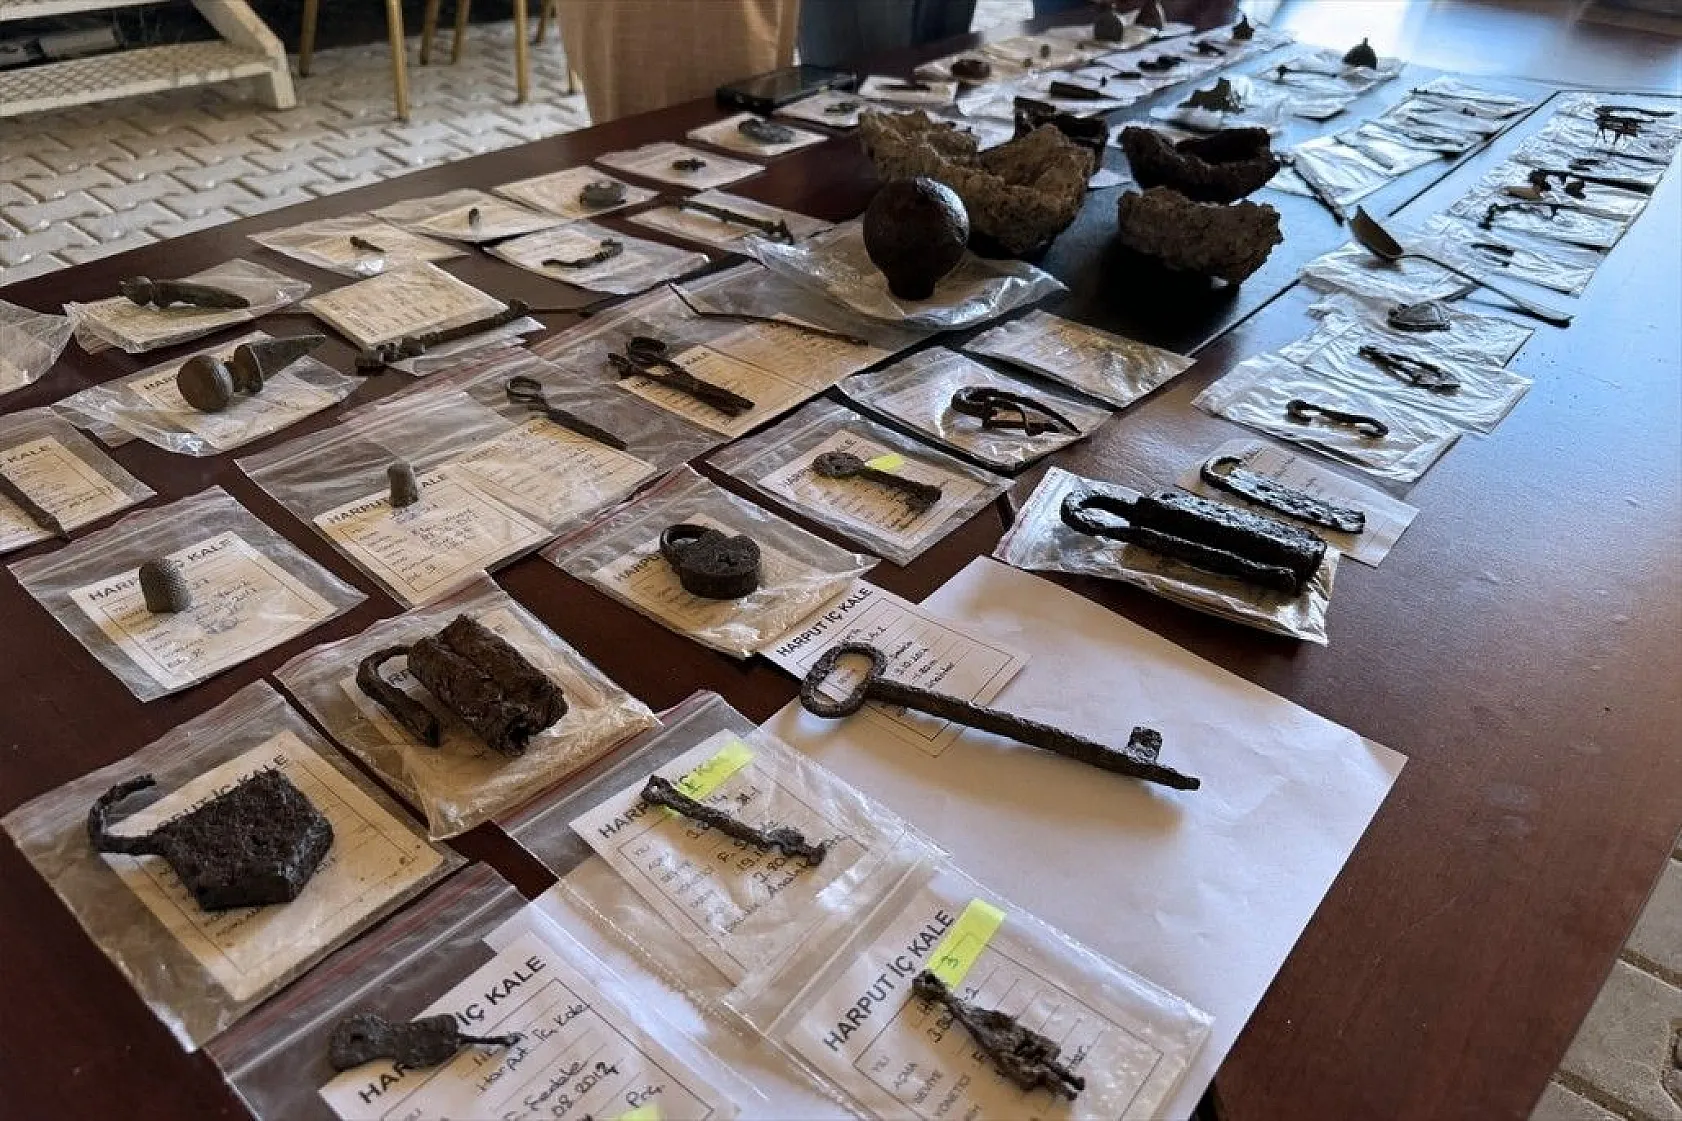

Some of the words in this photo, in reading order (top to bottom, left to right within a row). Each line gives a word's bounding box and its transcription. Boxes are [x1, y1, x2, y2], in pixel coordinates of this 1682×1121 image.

[776, 622, 828, 657] HARPUT
[838, 587, 874, 613] KALE
[456, 1004, 486, 1027] İÇ
[485, 953, 546, 1006] KALE
[823, 974, 895, 1052] HARPUT
[887, 953, 916, 980] İÇ
[907, 909, 956, 957] KALE
